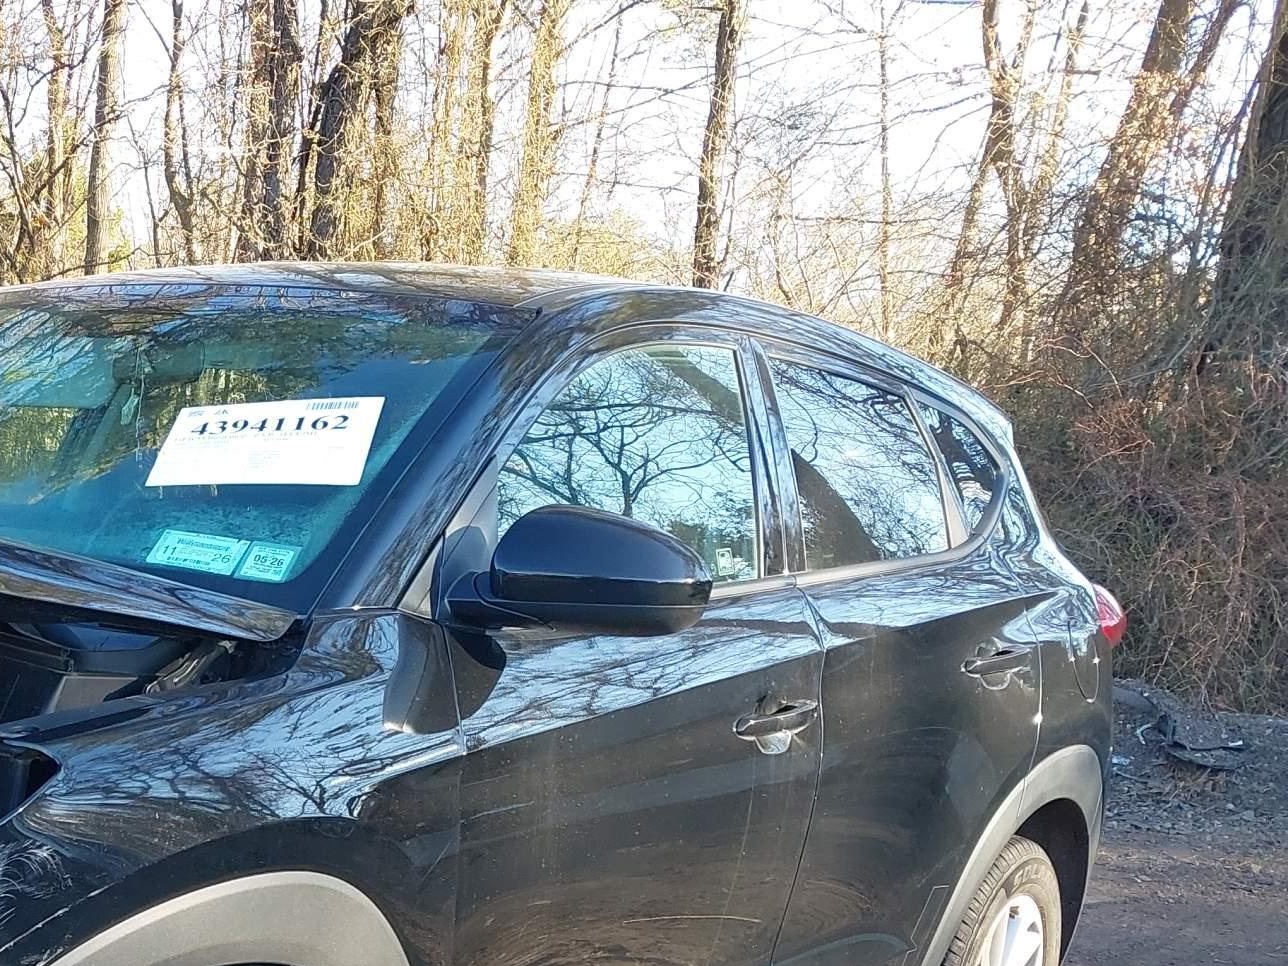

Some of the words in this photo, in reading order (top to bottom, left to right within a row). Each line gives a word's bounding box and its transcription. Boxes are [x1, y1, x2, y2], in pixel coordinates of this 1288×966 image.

[190, 414, 350, 436] 43941162
[163, 545, 177, 555] 11
[212, 553, 232, 563] 26
